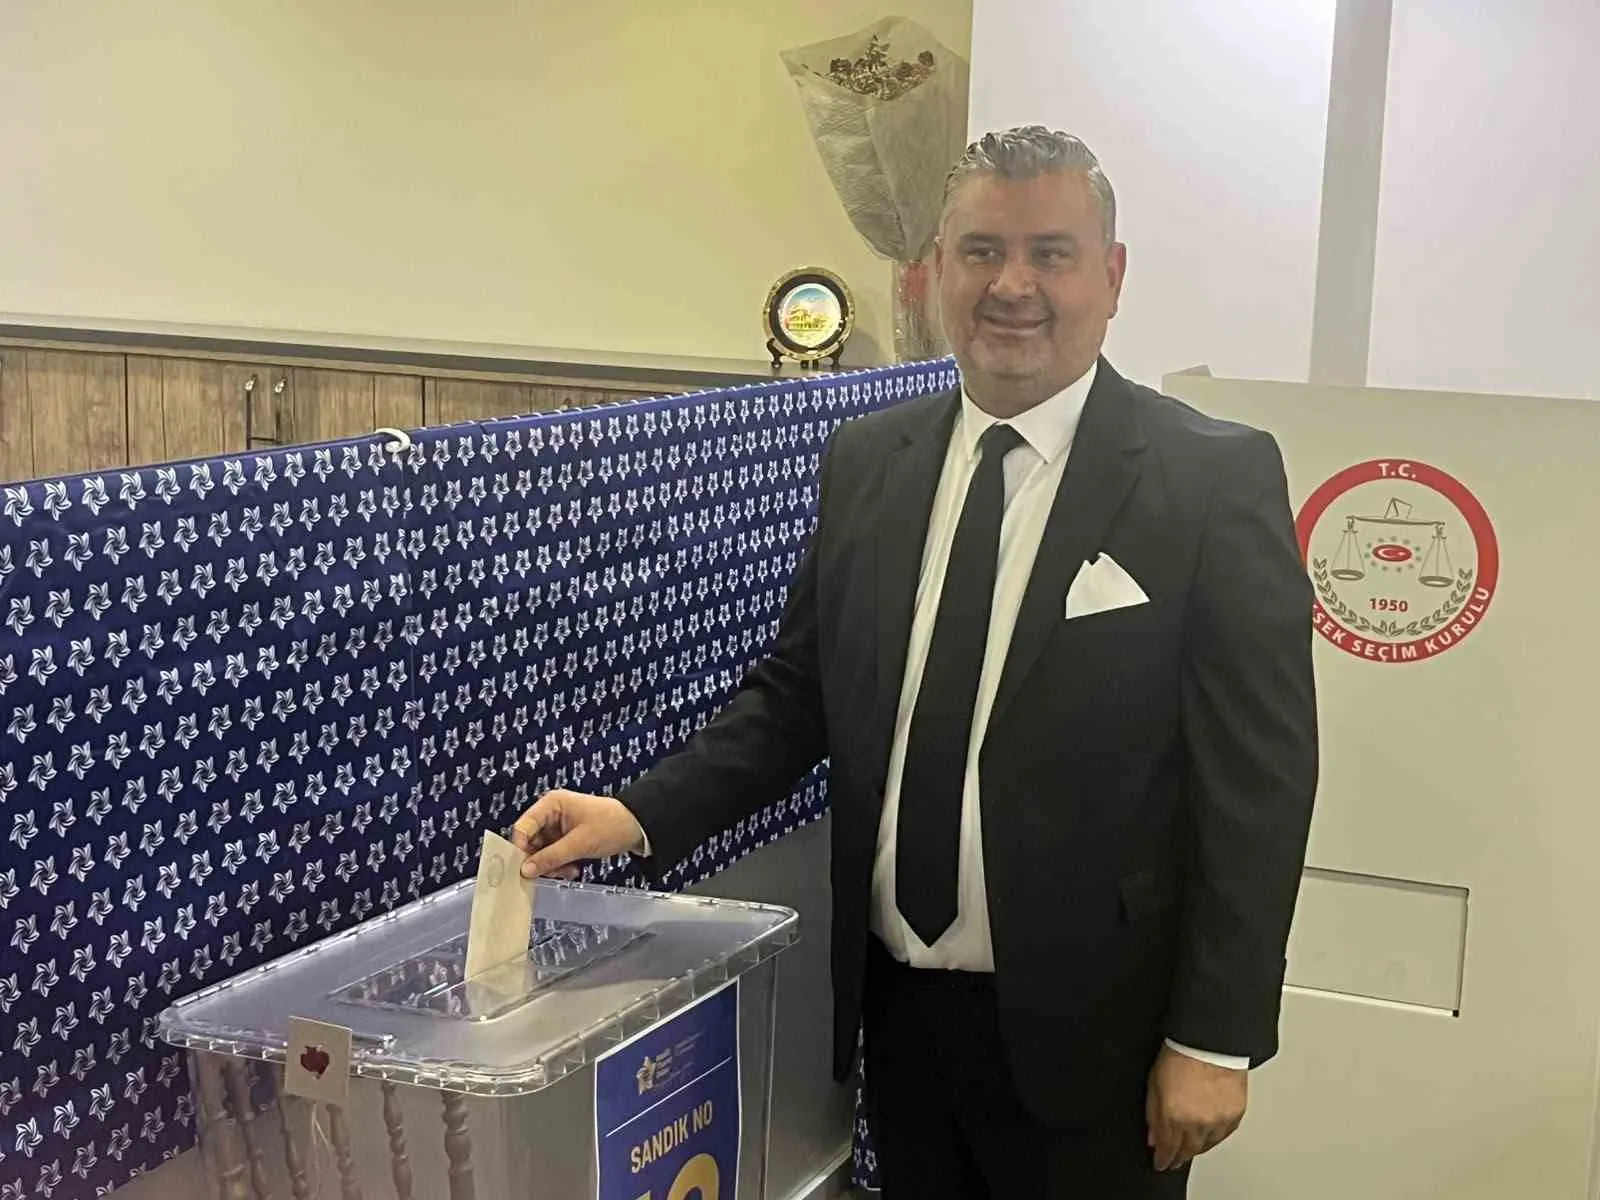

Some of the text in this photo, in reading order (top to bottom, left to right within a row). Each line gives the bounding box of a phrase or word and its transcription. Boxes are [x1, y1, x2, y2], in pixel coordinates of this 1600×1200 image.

[1378, 462, 1416, 478] T.C.
[1351, 640, 1417, 662] SEÇİM
[1425, 587, 1489, 653] KURULU
[1369, 598, 1408, 612] 1950
[630, 1100, 713, 1174] SANDIK NO
